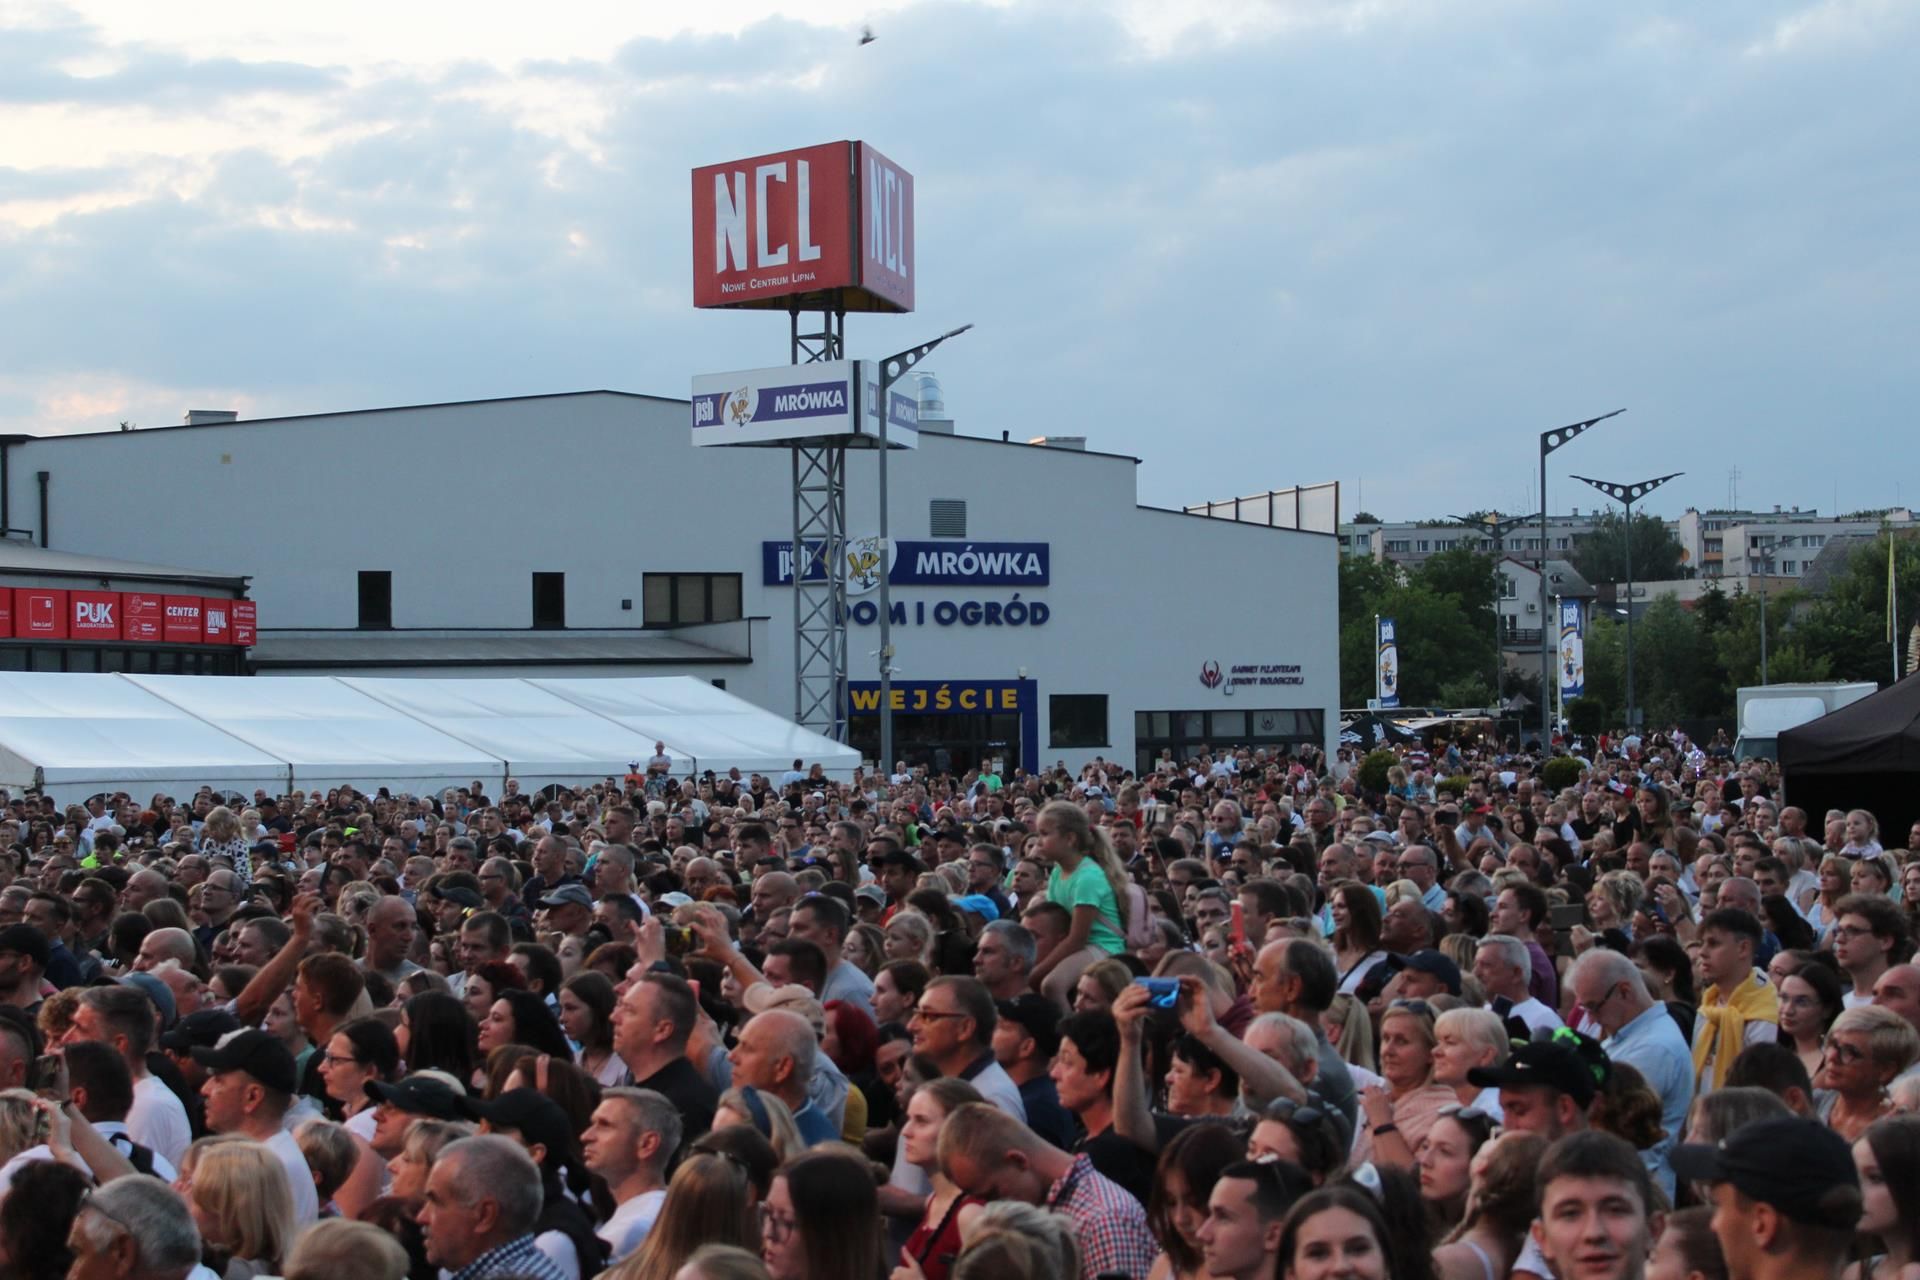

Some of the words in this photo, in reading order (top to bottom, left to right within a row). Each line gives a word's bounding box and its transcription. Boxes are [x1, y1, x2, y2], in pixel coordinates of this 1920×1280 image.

[715, 159, 821, 274] NCL
[870, 158, 907, 278] NCL
[695, 397, 714, 426] psb
[774, 388, 844, 413] MRÓWKA
[915, 545, 1042, 575] MRÓWKA
[76, 601, 113, 624] PUK
[167, 606, 200, 617] CENTER
[917, 601, 924, 625] I
[933, 593, 1050, 626] OGRÓD
[851, 684, 1018, 710] WEJŚCIE
